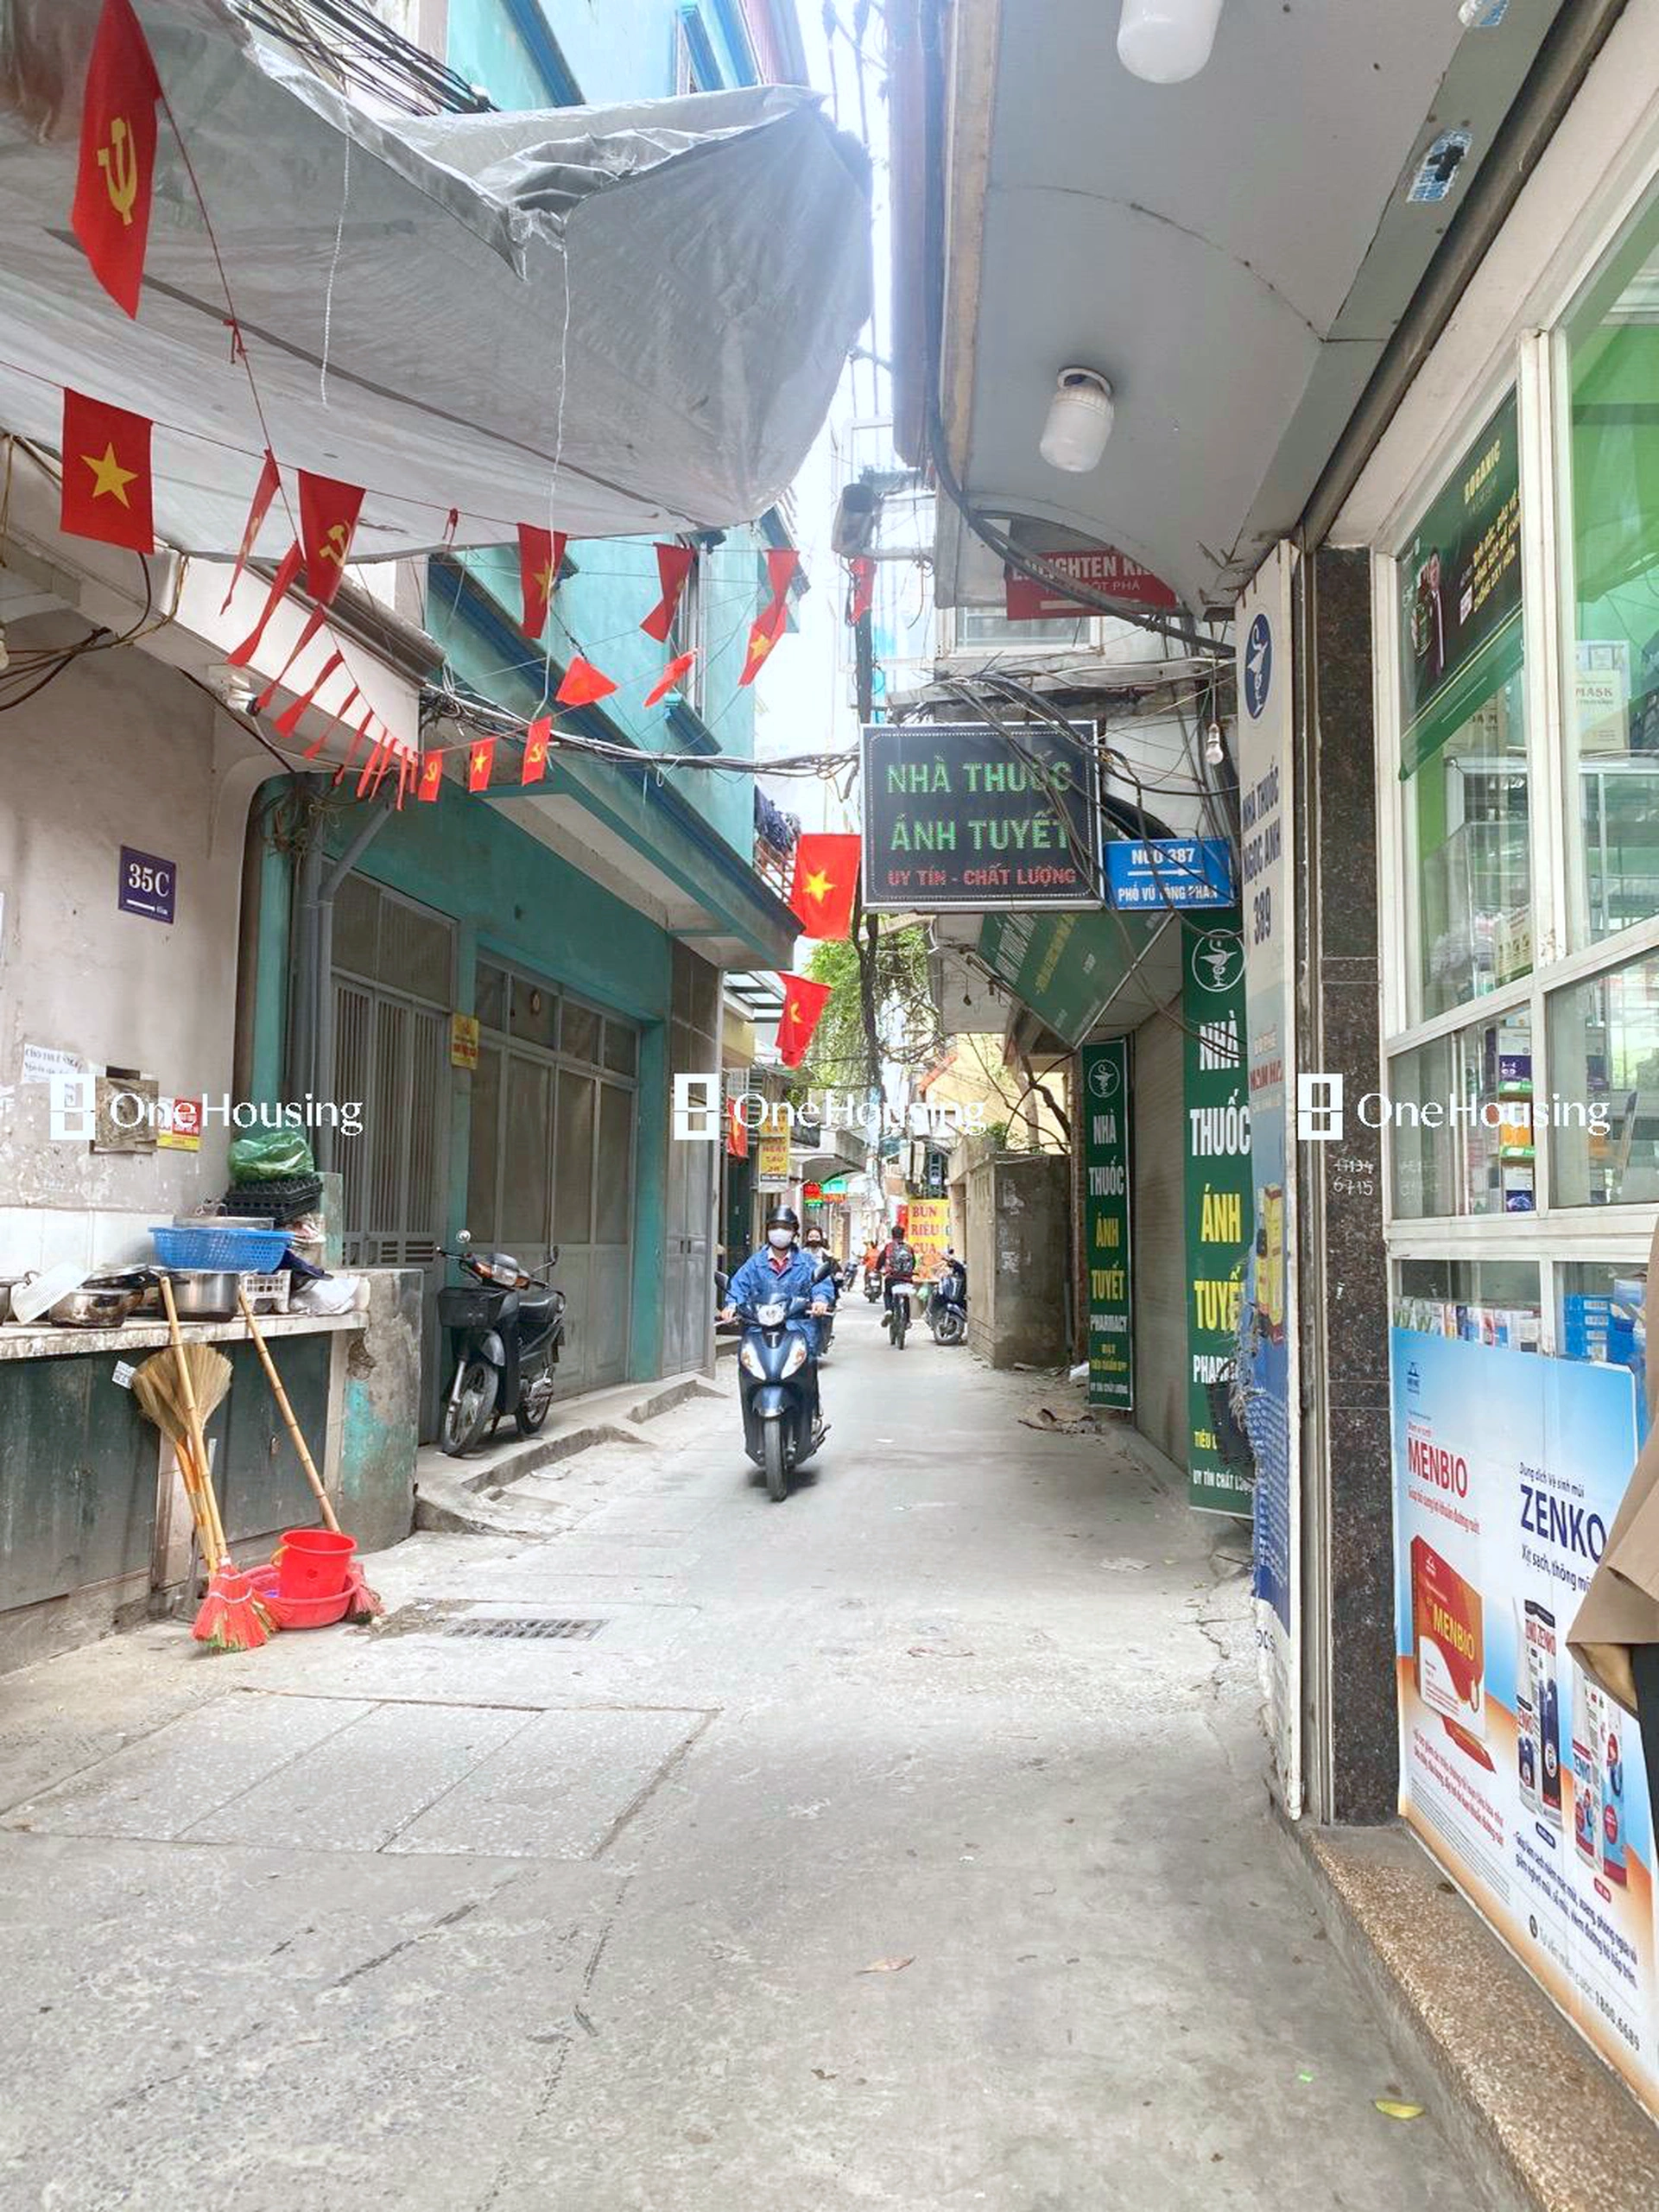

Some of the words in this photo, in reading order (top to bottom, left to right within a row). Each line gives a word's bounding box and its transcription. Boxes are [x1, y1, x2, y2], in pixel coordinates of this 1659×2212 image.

[1168, 847, 1195, 863] 387
[129, 863, 170, 897] 35C
[1118, 882, 1139, 903] PHỐ
[1143, 884, 1156, 902] VŨ
[1200, 1010, 1239, 1071] NHÀ
[1093, 1109, 1117, 1144] NHÀ
[1190, 1088, 1251, 1157] THUỐC
[1089, 1156, 1124, 1196] THUỐC
[1096, 1212, 1119, 1247] ÁNH
[1201, 1183, 1242, 1243] ÁNH
[1092, 1261, 1124, 1301] TUYẾT
[1194, 1265, 1244, 1331] TUYẾ
[1408, 1437, 1468, 1499] MENBIO
[1520, 1483, 1607, 1564] ZENKO
[1433, 1606, 1475, 1662] MENBIO
